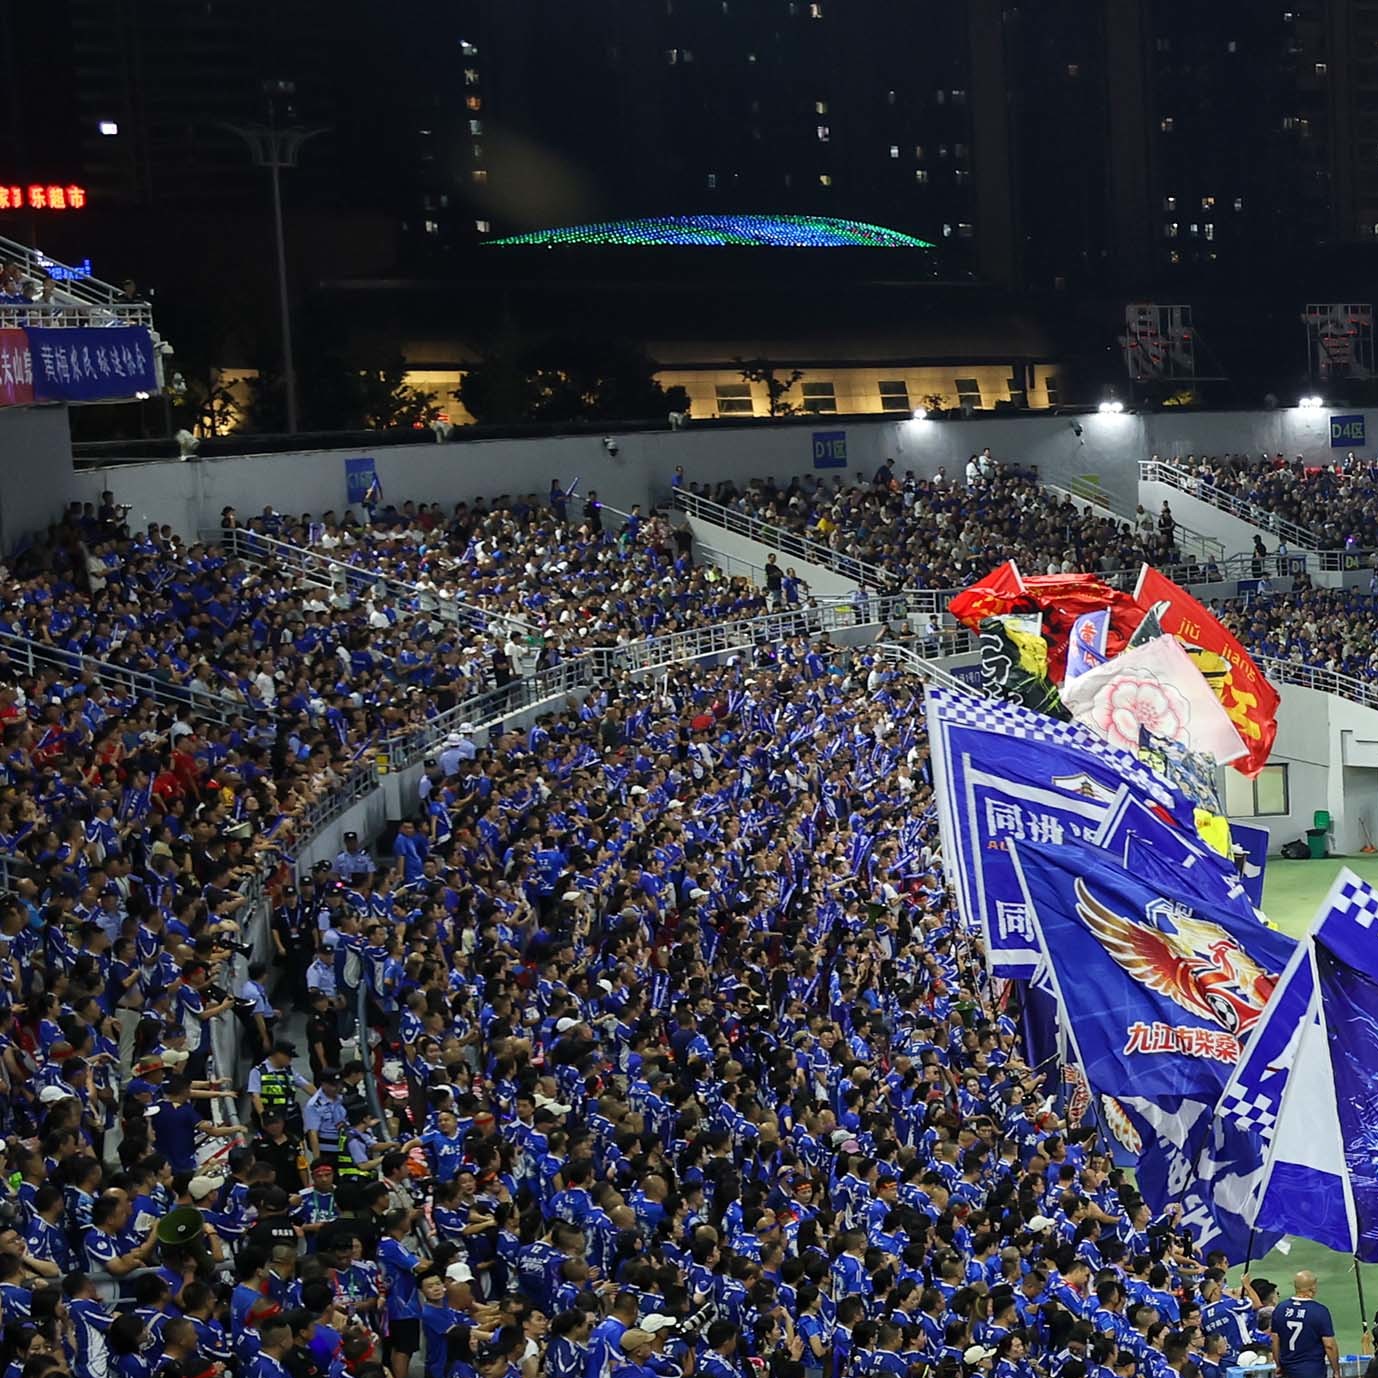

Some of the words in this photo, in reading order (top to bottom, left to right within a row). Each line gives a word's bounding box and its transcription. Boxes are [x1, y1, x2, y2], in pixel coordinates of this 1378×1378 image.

[1332, 423, 1363, 438] D4区
[1124, 1021, 1244, 1064] 九江市柴桑
[1286, 1320, 1303, 1351] 7
